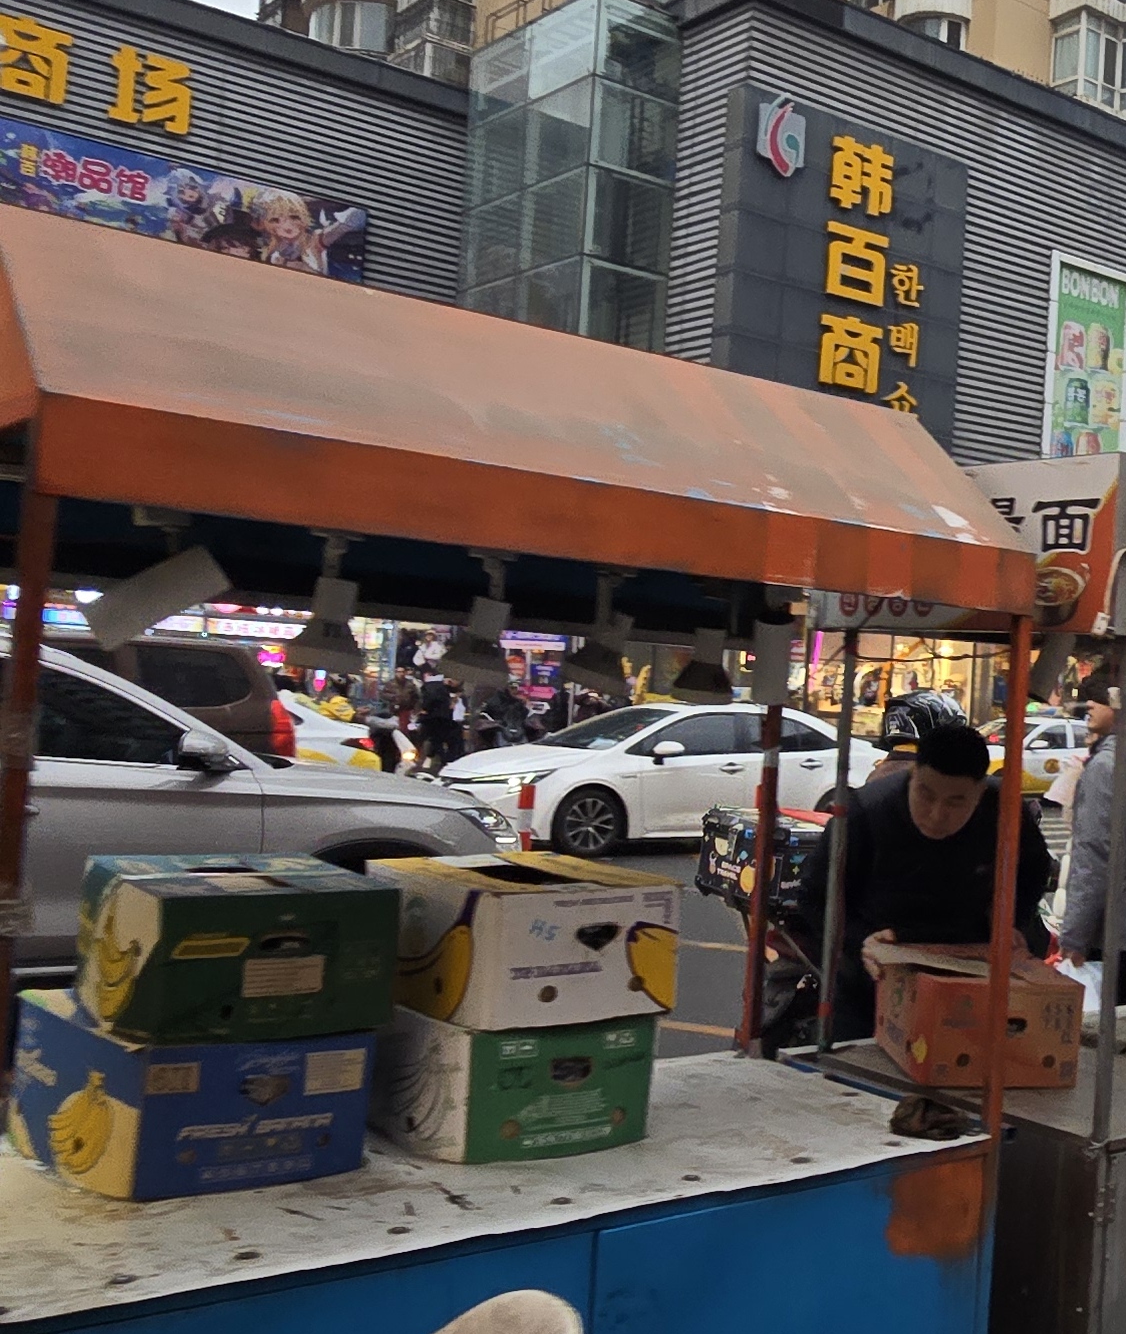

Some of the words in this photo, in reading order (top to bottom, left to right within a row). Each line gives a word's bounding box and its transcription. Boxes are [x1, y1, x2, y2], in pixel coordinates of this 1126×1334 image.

[0, 13, 192, 135] 商场
[819, 136, 894, 394] 韩百商
[1061, 267, 1120, 309] BONBON
